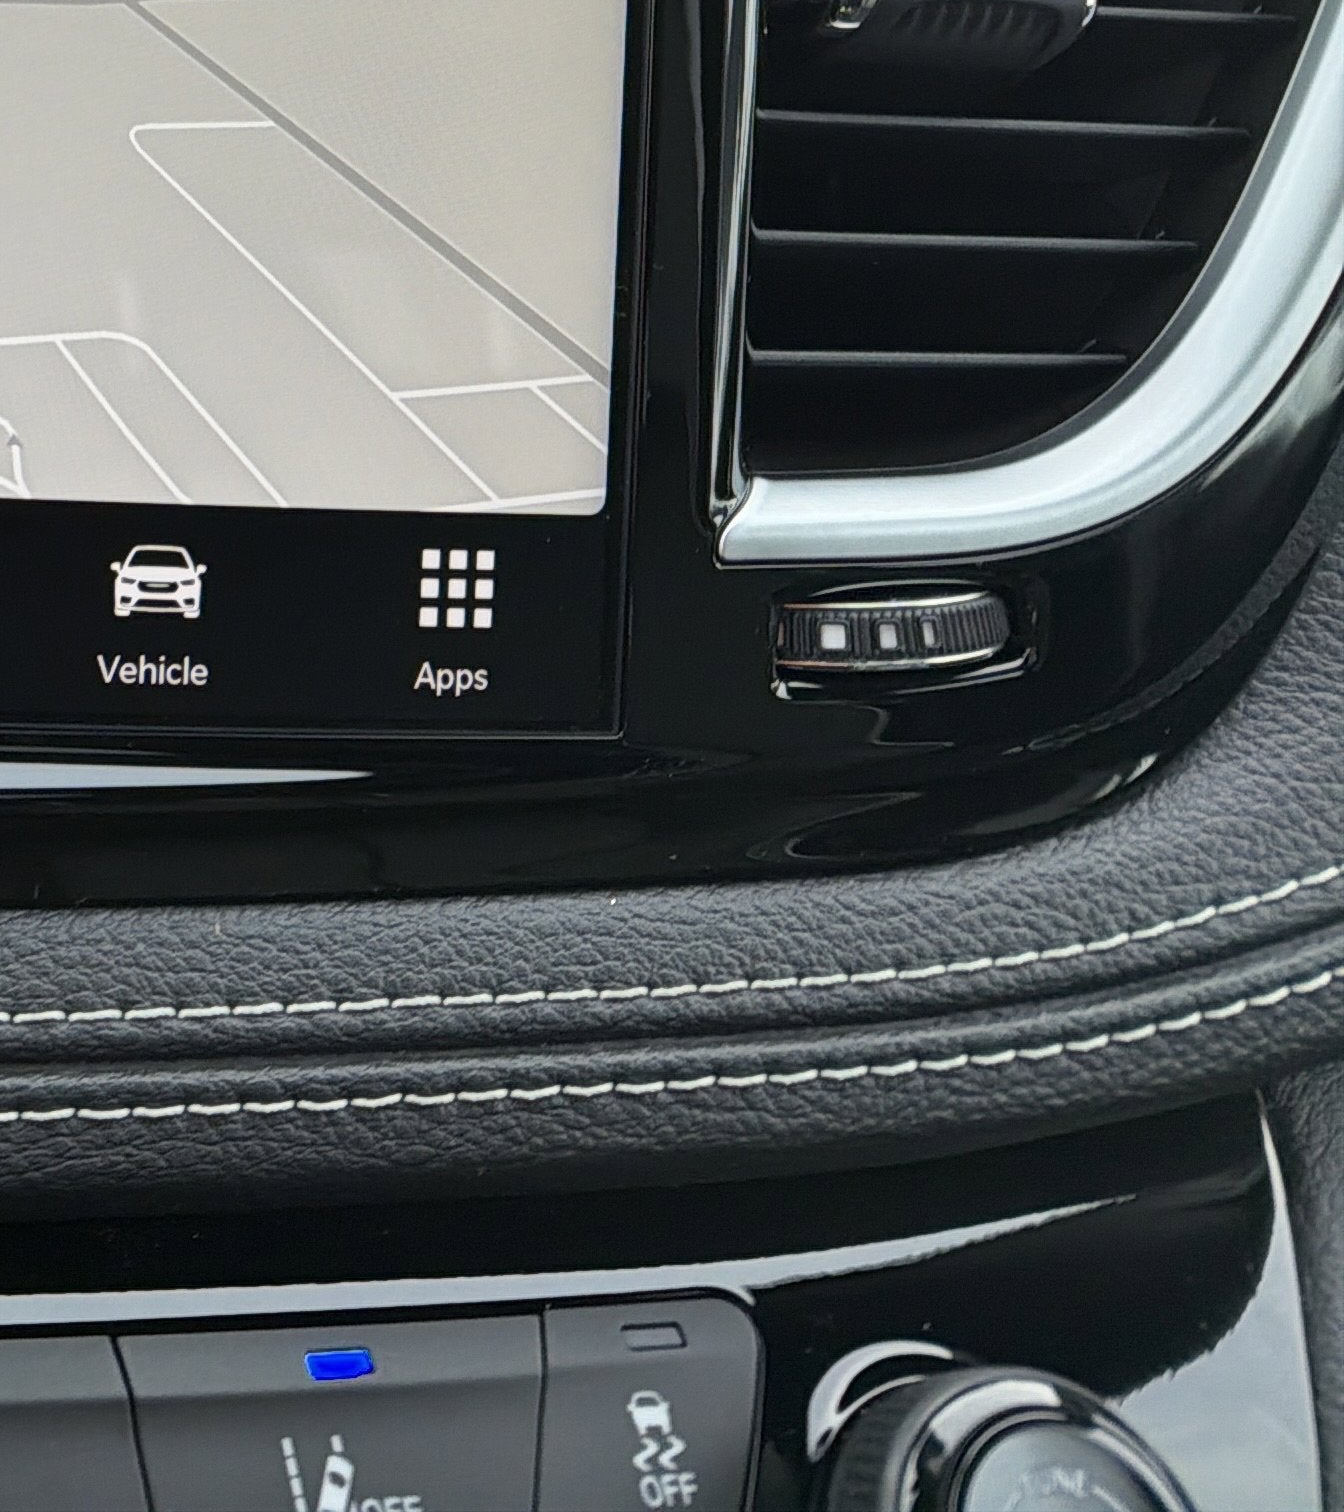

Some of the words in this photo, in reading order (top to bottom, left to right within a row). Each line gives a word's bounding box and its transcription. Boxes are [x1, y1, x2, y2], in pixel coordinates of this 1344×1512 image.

[97, 654, 210, 689] Vehicle
[414, 662, 489, 697] Apps
[640, 1473, 697, 1508] OFF
